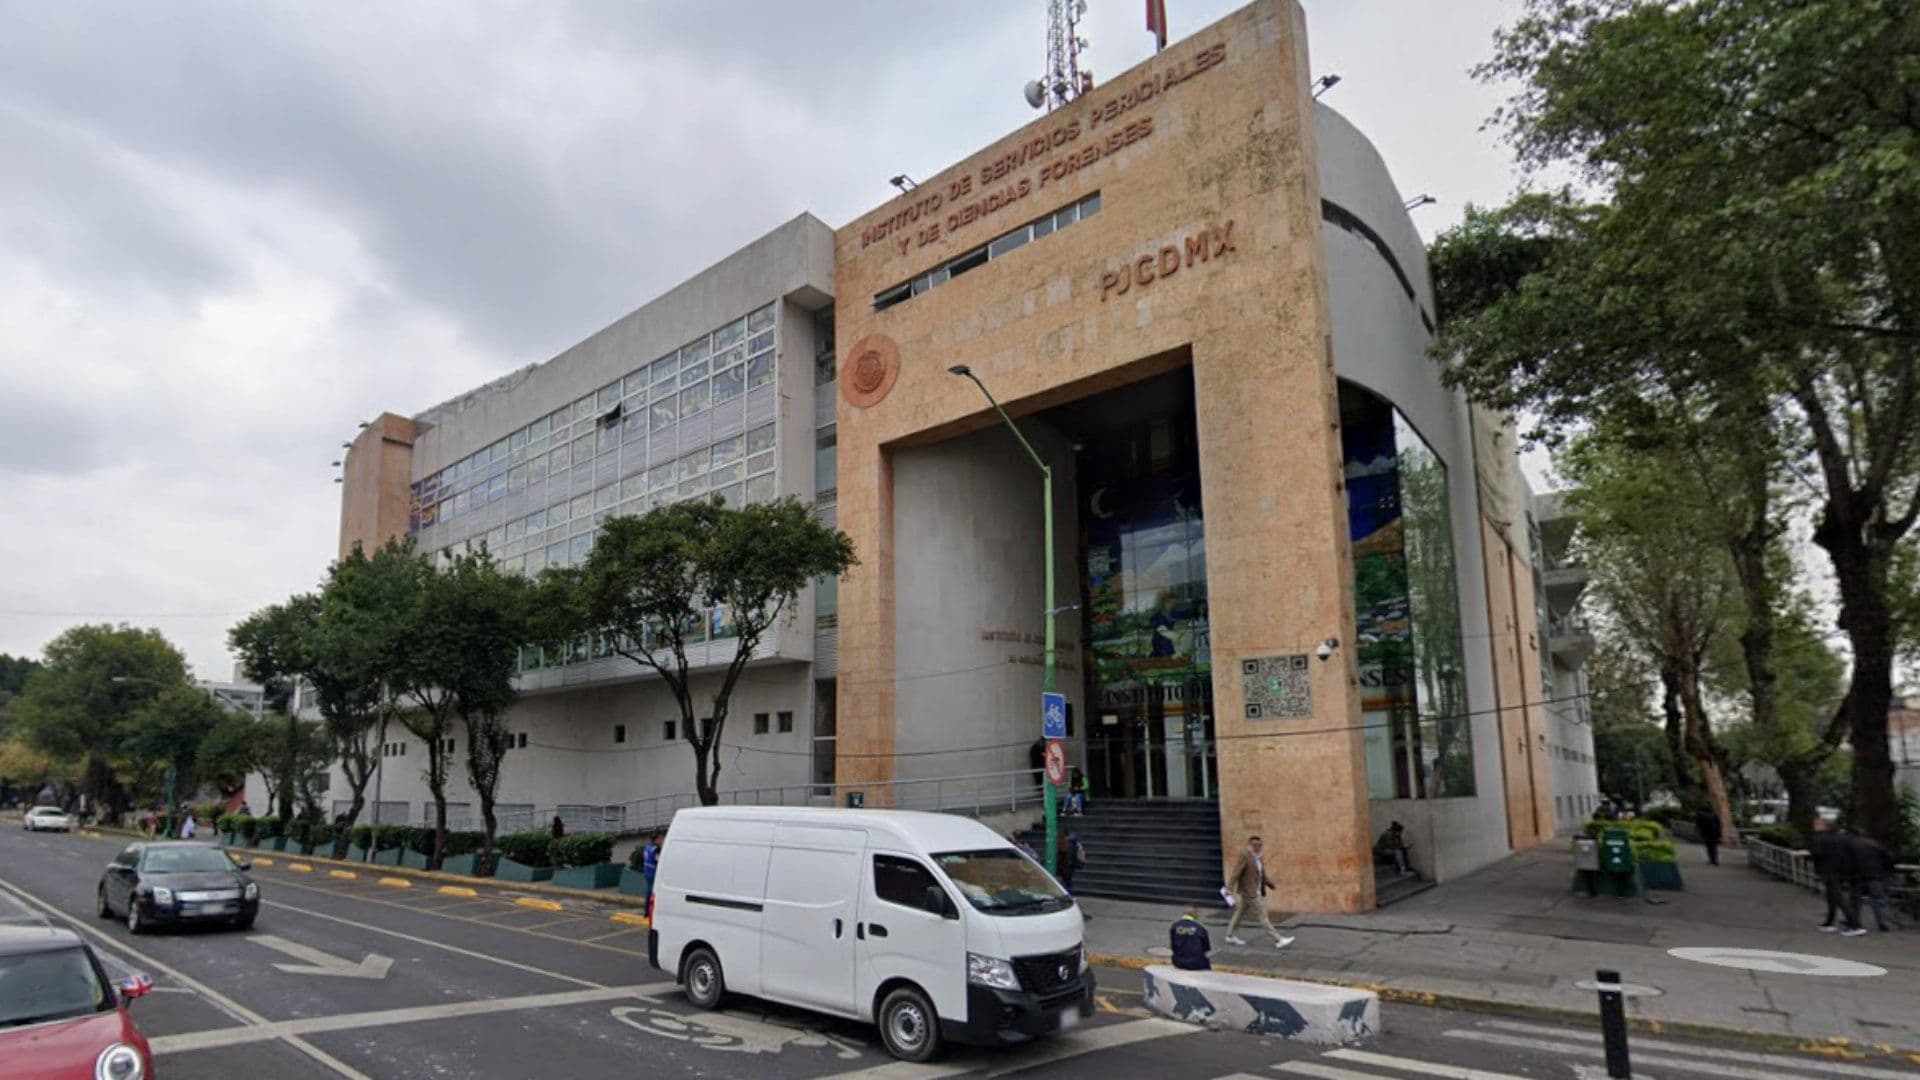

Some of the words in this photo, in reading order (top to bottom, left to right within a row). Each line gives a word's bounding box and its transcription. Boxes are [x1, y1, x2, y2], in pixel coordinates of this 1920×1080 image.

[860, 193, 944, 249] INSTITUTO
[950, 175, 973, 201] DE
[980, 121, 1081, 186] SERVICIOS
[1090, 42, 1227, 130] PERICIALES
[897, 236, 911, 256] Y
[917, 223, 941, 248] DE
[947, 176, 1032, 232] CIENCIAS
[1039, 117, 1154, 188] FORENSES
[1099, 218, 1237, 303] PJCDMX
